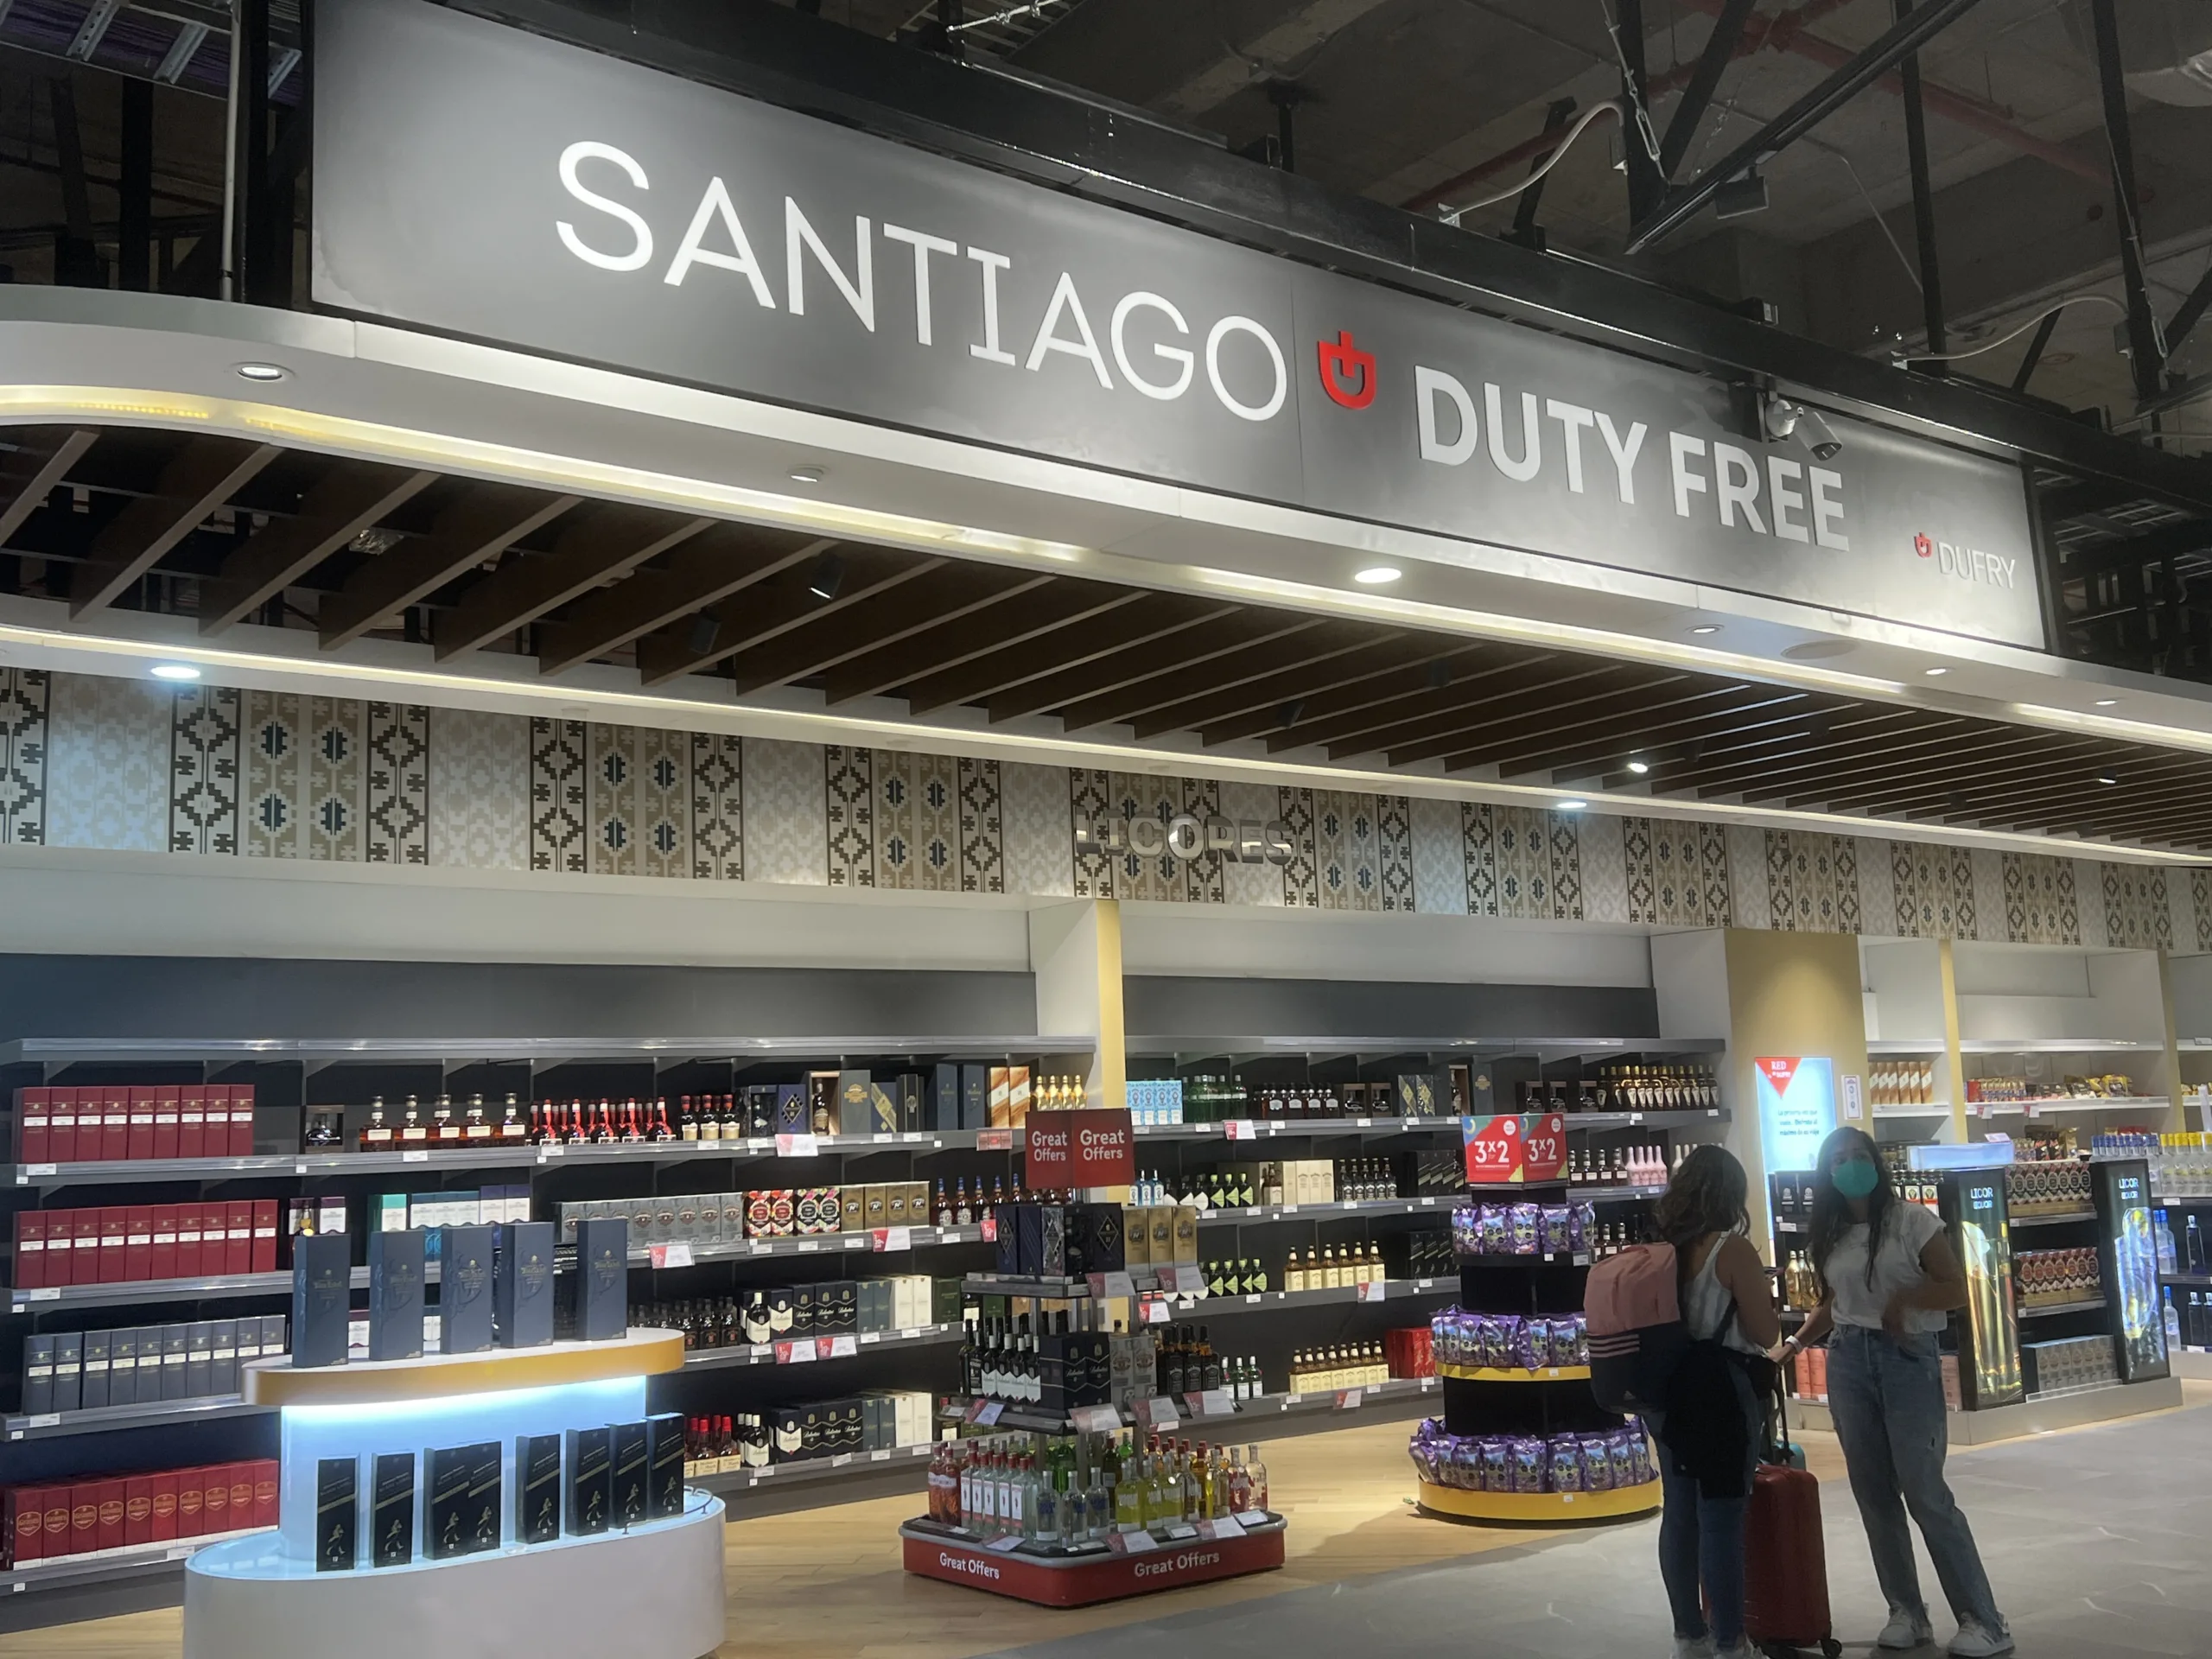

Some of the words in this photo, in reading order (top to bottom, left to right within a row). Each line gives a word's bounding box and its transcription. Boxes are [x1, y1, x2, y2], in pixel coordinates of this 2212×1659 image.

[556, 140, 1287, 422] SANTIAGO
[1414, 364, 1648, 505] DUTY
[1669, 430, 1850, 553] FREE
[1936, 541, 2016, 590] DUFRY
[1076, 806, 1294, 866] LICORES
[1770, 1060, 1787, 1071] RED
[1032, 1130, 1068, 1147] Great
[1079, 1128, 1126, 1146] Great
[1033, 1147, 1067, 1162] Offers
[1083, 1146, 1124, 1161] Offers
[2119, 1177, 2139, 1189] LICOR
[1970, 1186, 1994, 1199] LICOR
[939, 1552, 967, 1572] Great
[968, 1556, 1000, 1580] Offers
[1135, 1558, 1173, 1578] Great
[1177, 1551, 1220, 1571] Offers
